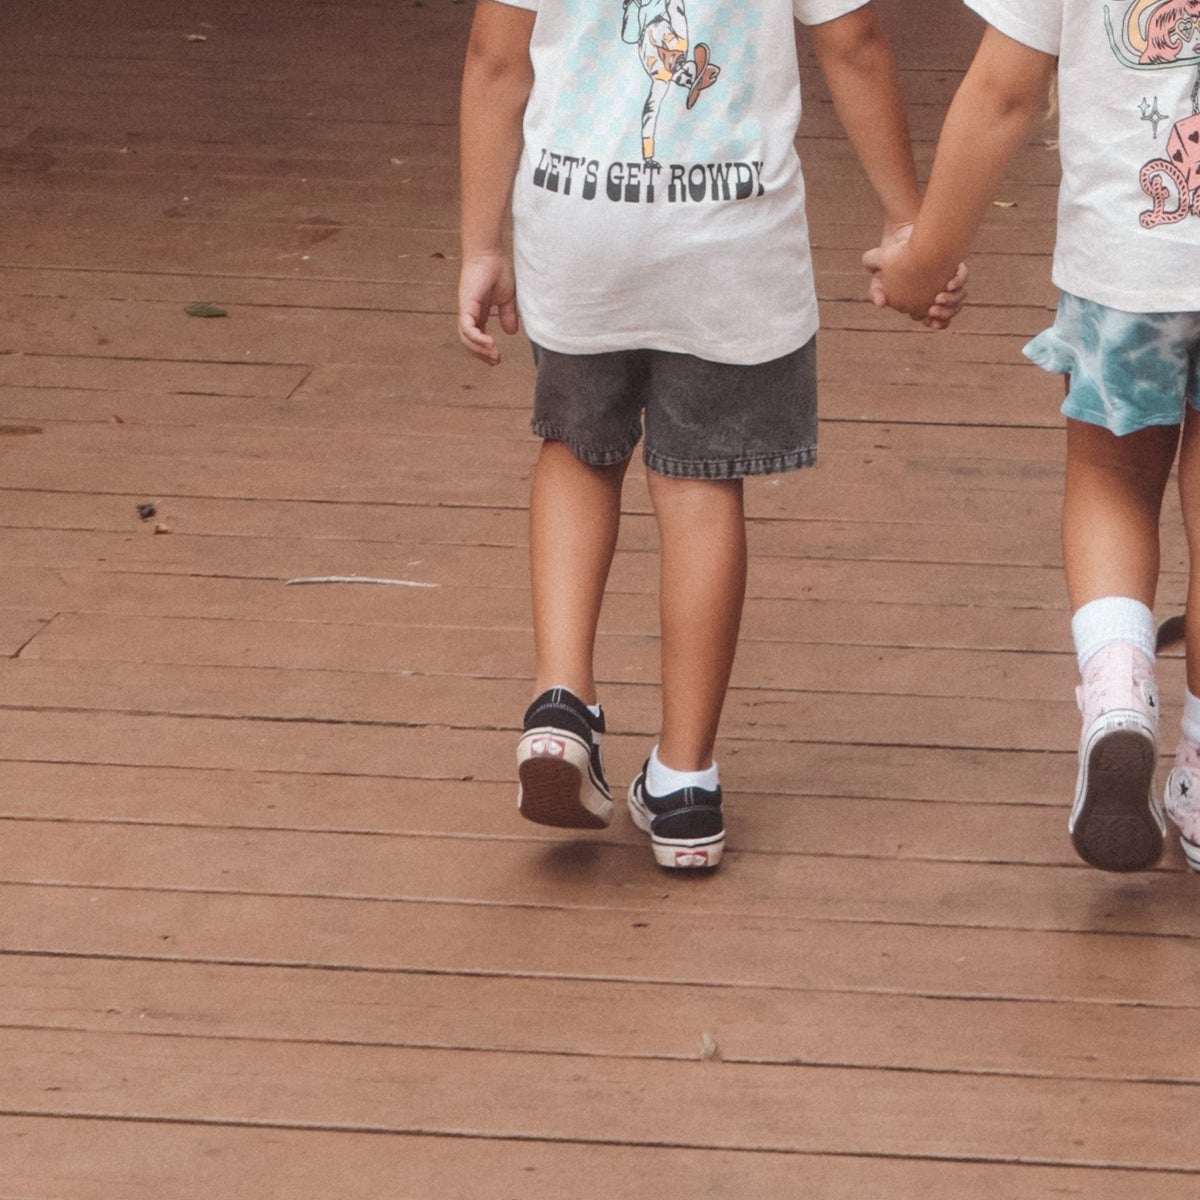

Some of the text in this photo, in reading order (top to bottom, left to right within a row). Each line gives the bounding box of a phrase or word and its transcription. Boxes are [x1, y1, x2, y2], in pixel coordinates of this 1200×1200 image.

[533, 148, 765, 203] LET'S GET ROWDY
